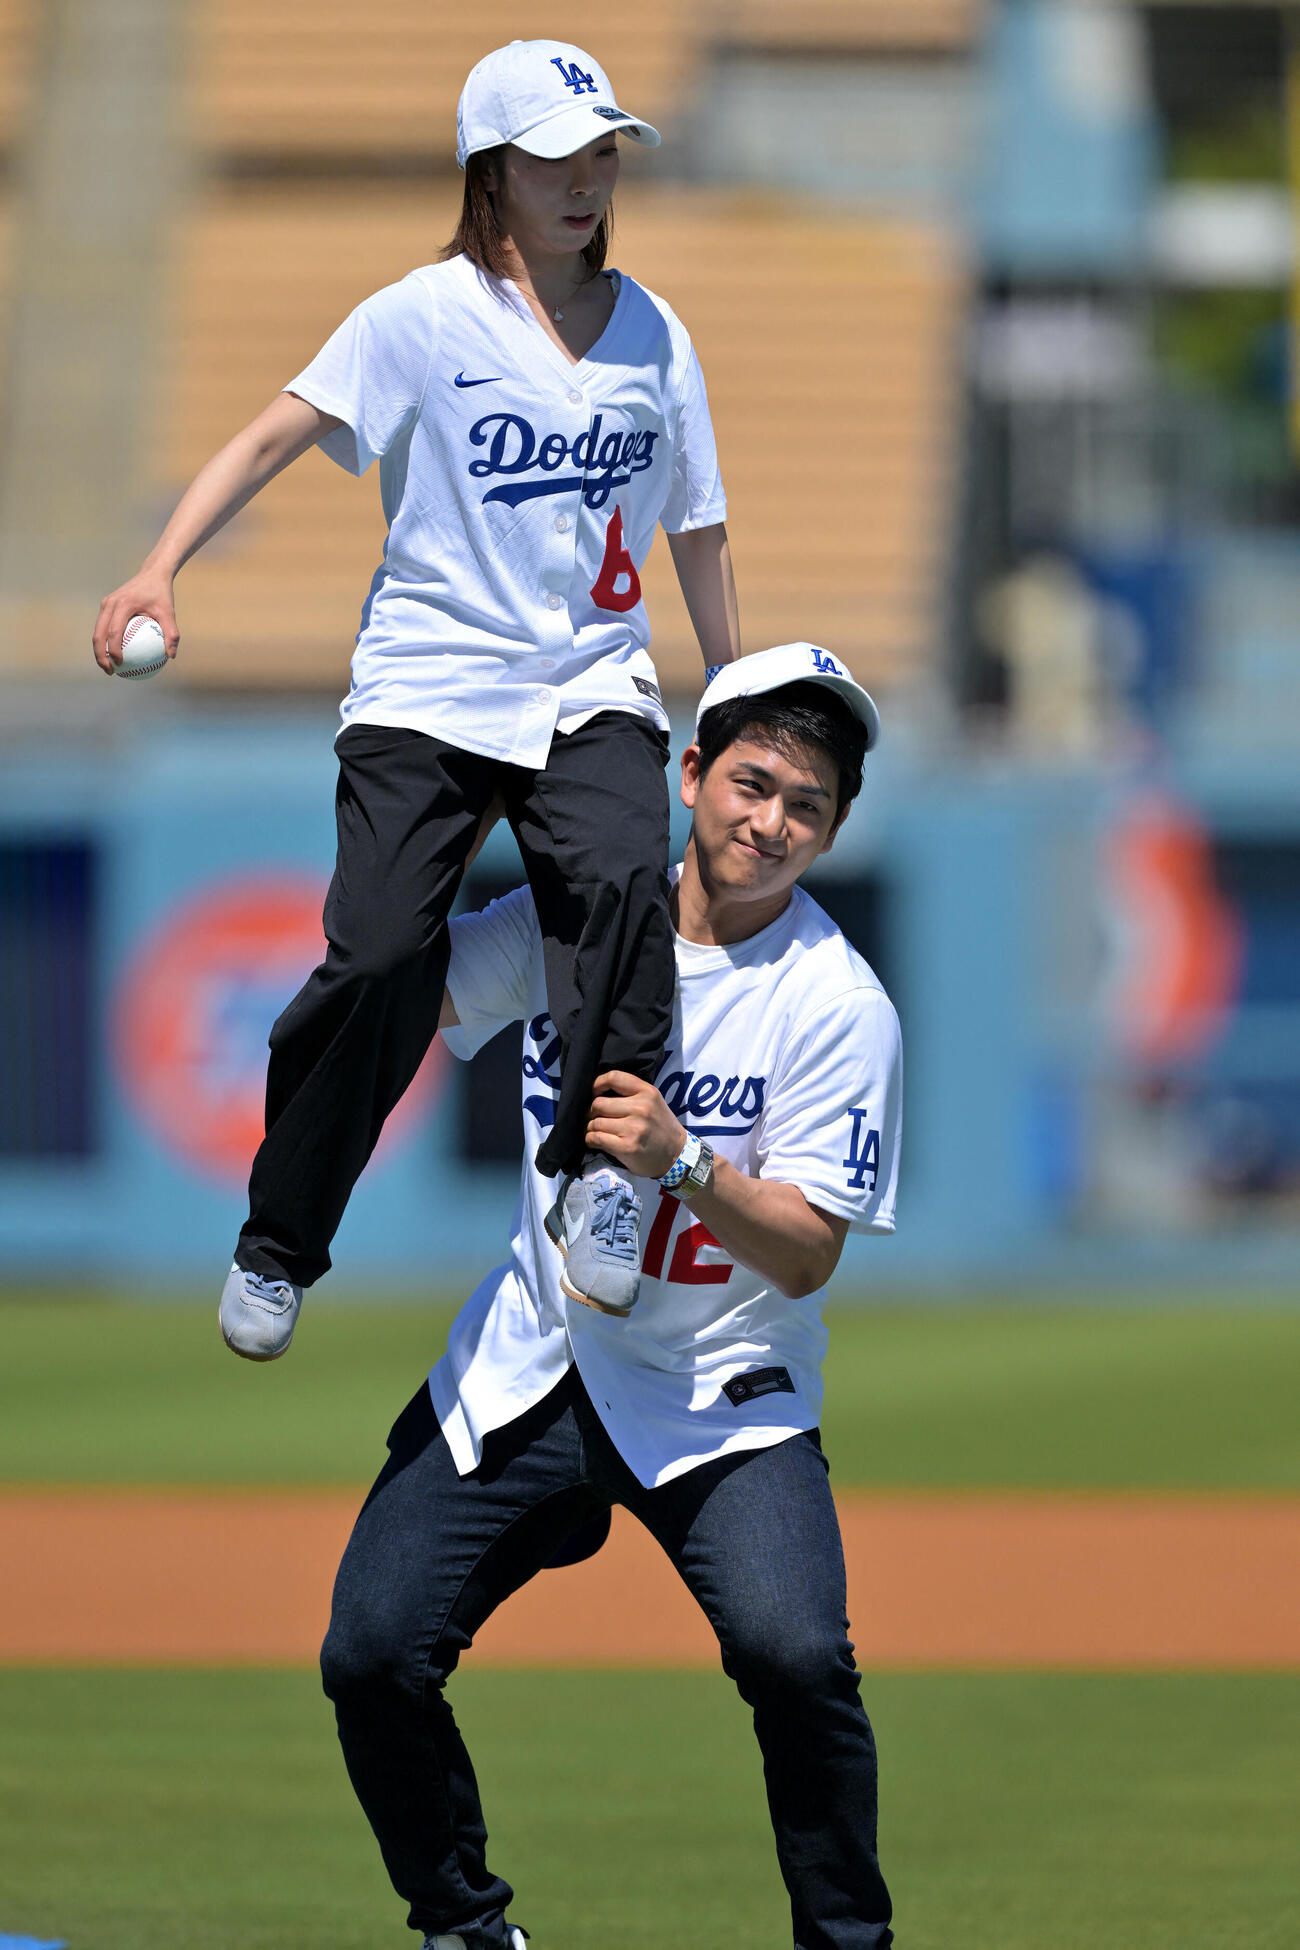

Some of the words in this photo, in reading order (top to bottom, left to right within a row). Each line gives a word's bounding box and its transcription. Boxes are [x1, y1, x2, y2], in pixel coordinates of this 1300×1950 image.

[550, 57, 598, 94] LA
[468, 412, 659, 510] Dodgers
[590, 504, 642, 613] 6
[811, 649, 843, 676] LA
[522, 1012, 767, 1119] Dgers
[843, 1108, 880, 1191] LA
